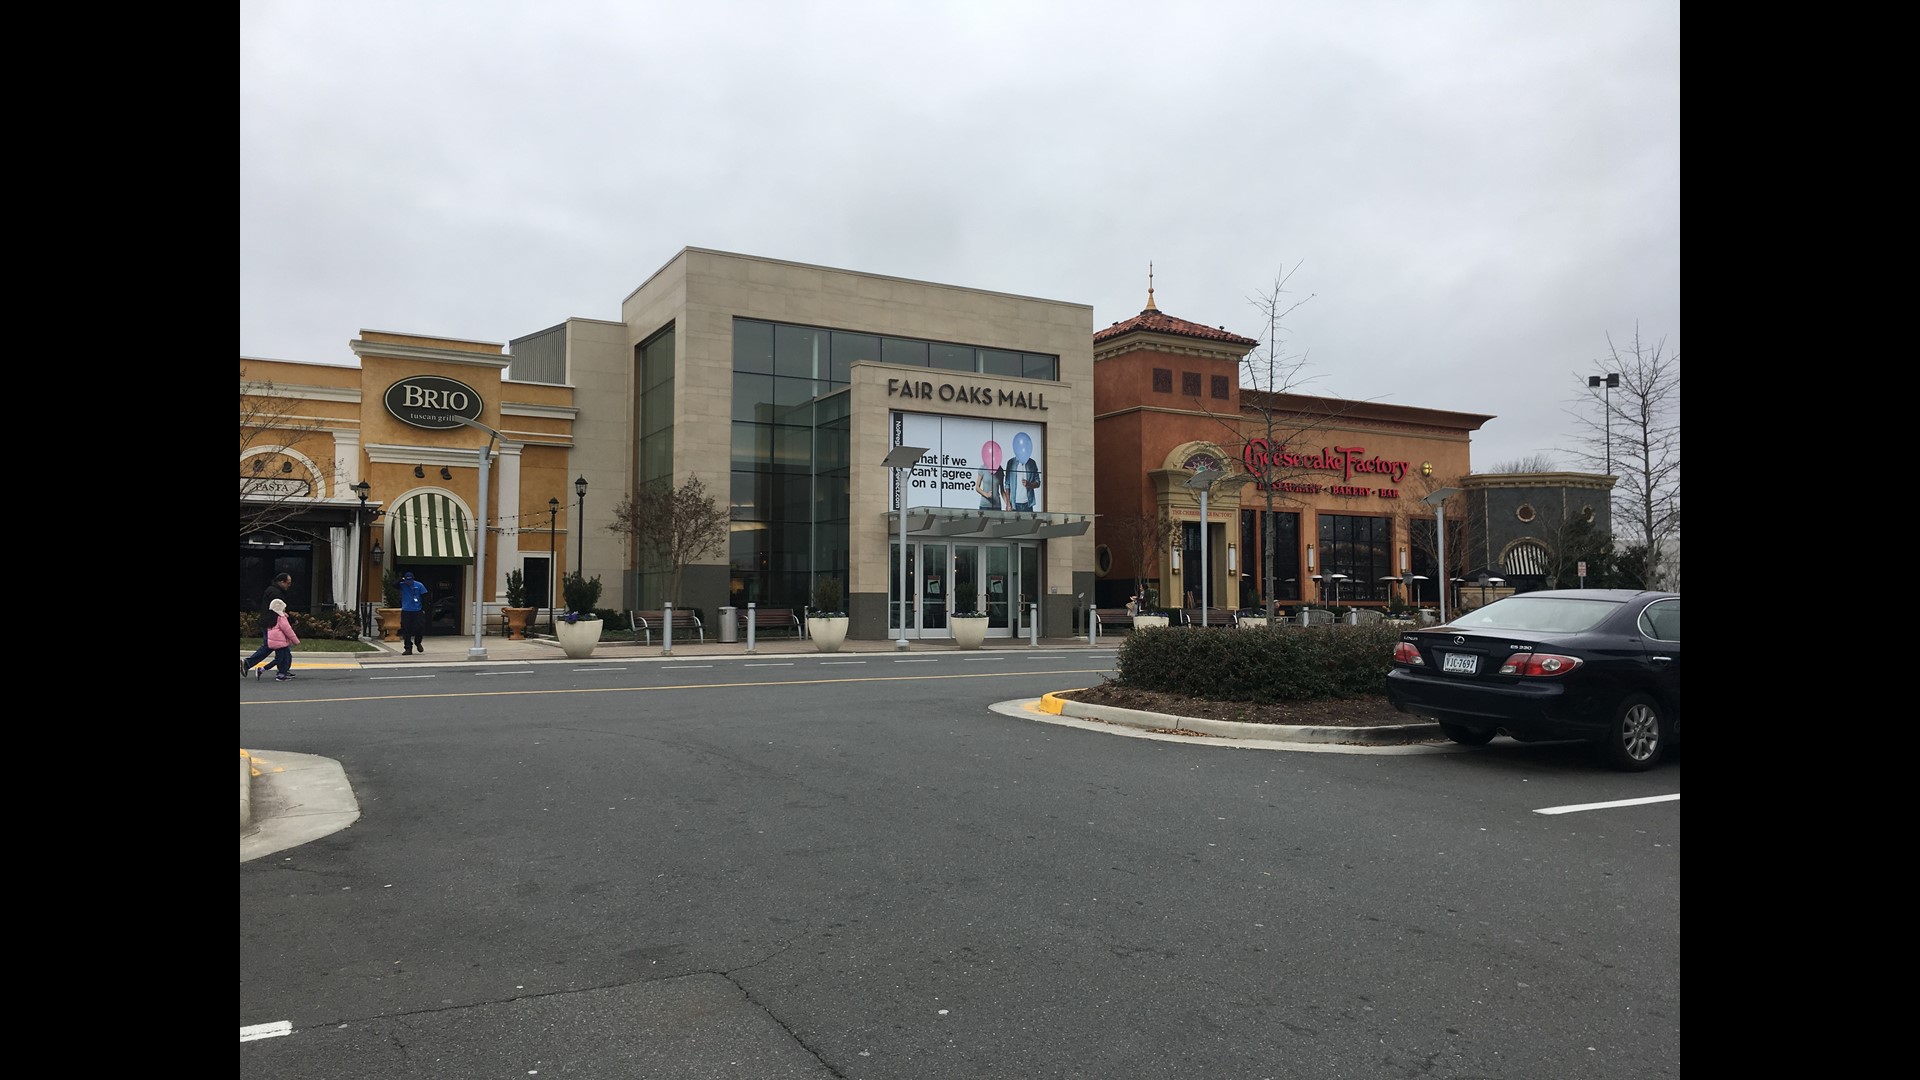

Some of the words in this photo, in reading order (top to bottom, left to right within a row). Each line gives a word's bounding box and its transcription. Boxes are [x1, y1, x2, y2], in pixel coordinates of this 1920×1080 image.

[888, 379, 933, 400] FAIR
[938, 384, 993, 406] OAKS
[998, 389, 1048, 410] MALL
[914, 454, 938, 465] hat
[942, 455, 950, 465] if
[951, 457, 967, 466] we
[1243, 437, 1344, 478] Cheesecake
[1334, 446, 1411, 483] Factory
[942, 470, 972, 480] agree
[255, 483, 289, 491] PASTA
[911, 479, 926, 488] on
[930, 480, 937, 489] a
[941, 480, 976, 491] name?
[1257, 482, 1322, 493] RSTAURANT
[1331, 485, 1371, 497] BAKERY
[1378, 489, 1400, 499] BAR
